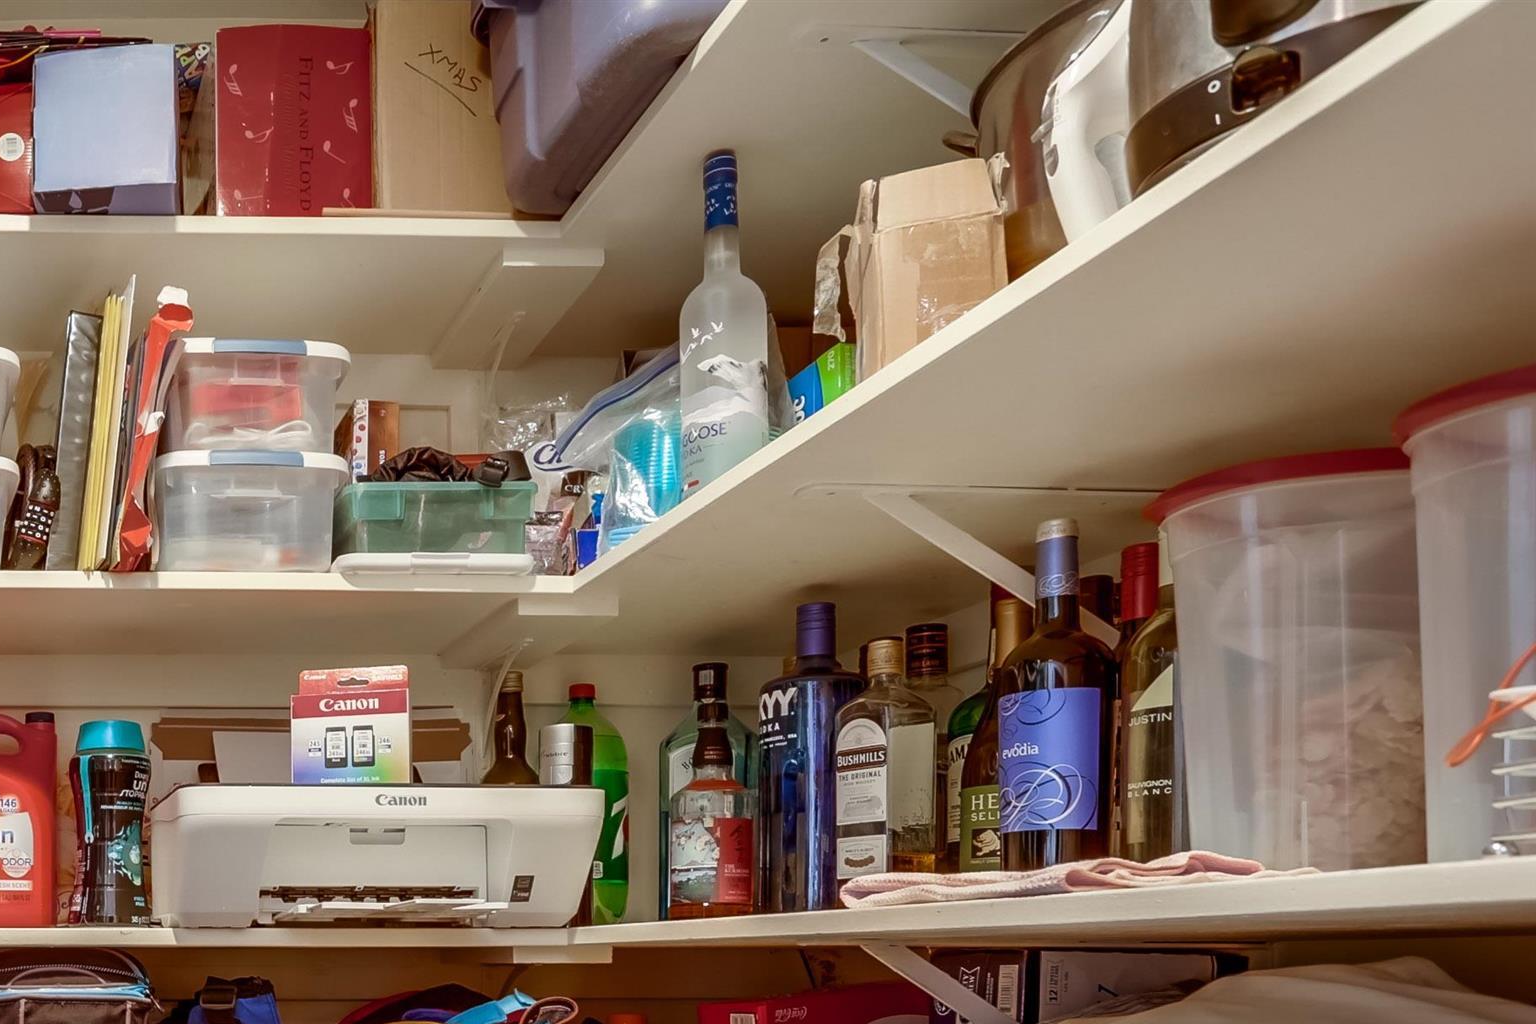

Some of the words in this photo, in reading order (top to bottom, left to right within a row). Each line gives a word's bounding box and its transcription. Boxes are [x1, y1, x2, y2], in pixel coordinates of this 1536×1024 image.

[419, 43, 482, 92] XMAS
[299, 56, 313, 103] FITZ
[299, 109, 309, 140] AND
[299, 146, 313, 211] FLOYD
[319, 697, 380, 712] Canon
[1128, 711, 1172, 727] JUSTIN
[837, 751, 885, 768] BUSHMILLS
[851, 771, 881, 780] ORIGINAL
[1128, 779, 1172, 790] SAUVIGNON
[375, 794, 427, 807] Canon
[1128, 787, 1172, 799] BLANC
[0, 798, 16, 808] 146
[2, 858, 31, 866] ODOR
